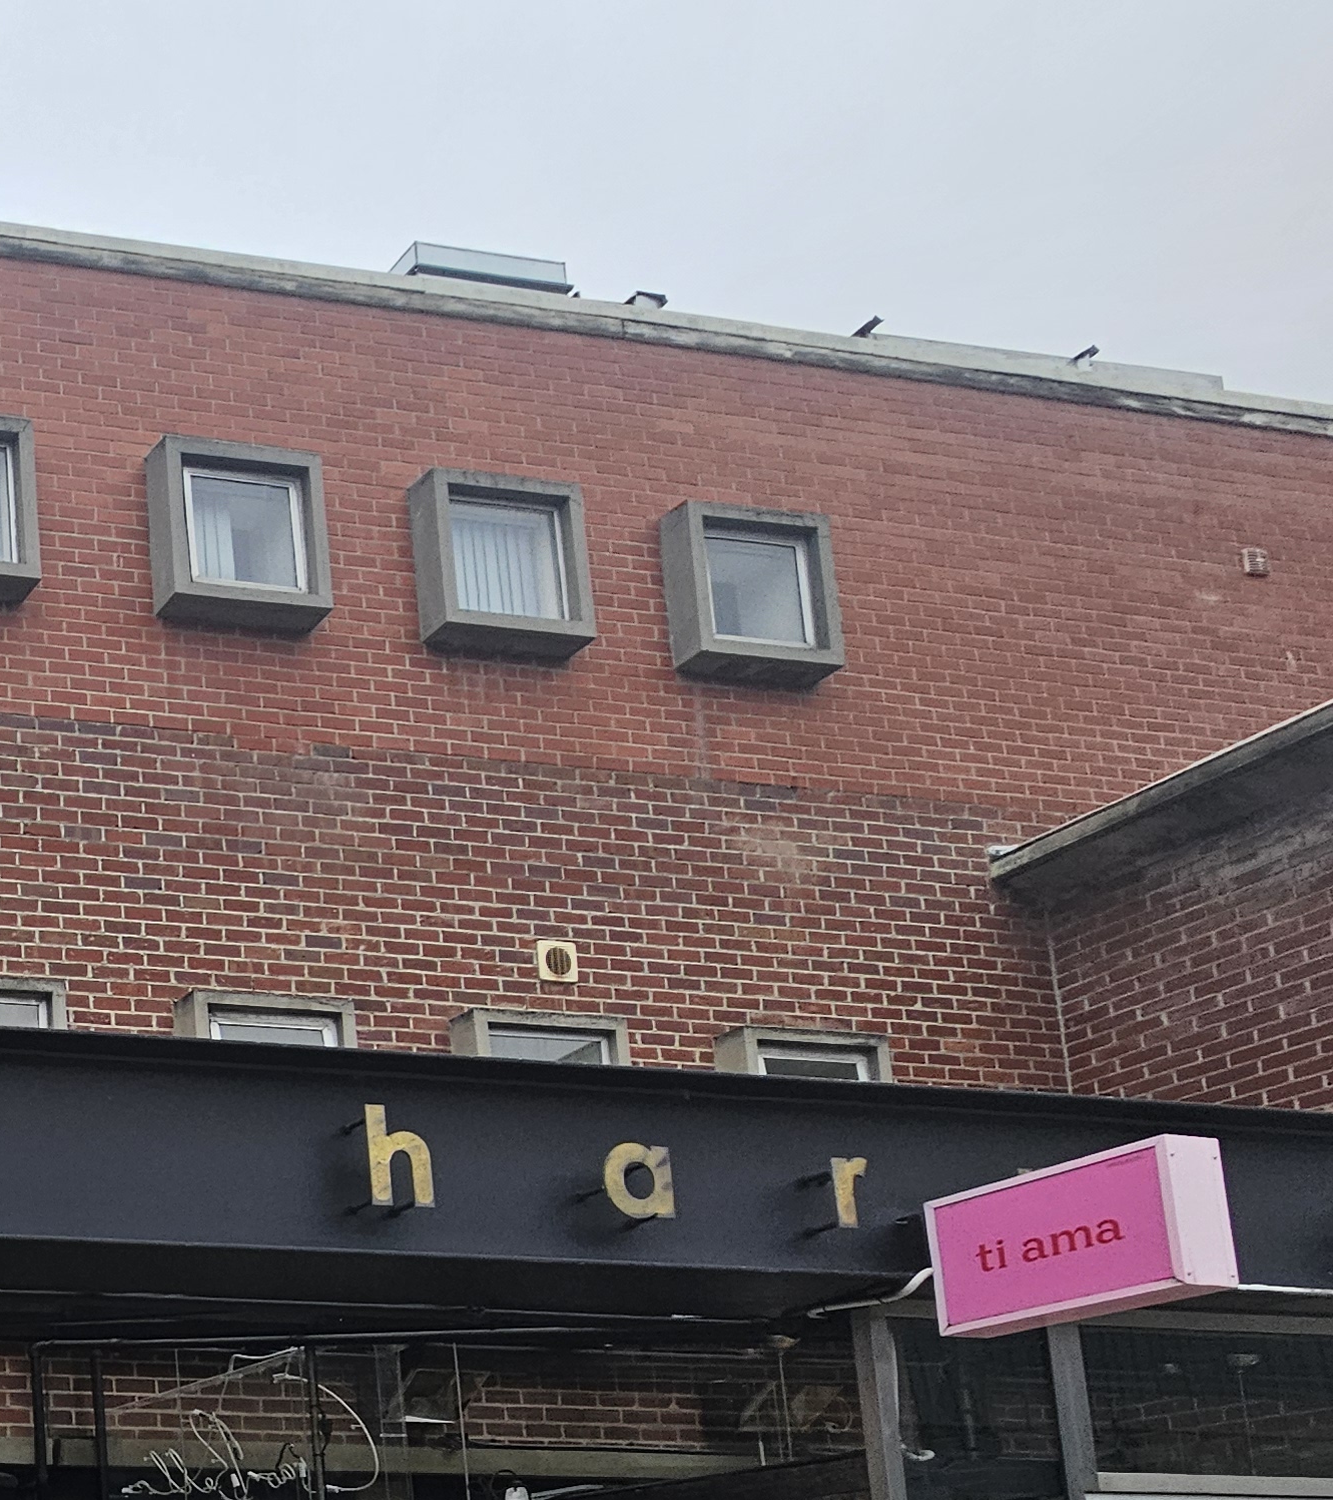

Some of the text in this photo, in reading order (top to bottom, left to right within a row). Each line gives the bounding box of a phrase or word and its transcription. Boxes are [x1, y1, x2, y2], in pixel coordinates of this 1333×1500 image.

[365, 1104, 1035, 1228] har
[976, 1218, 1126, 1272] ti ama
